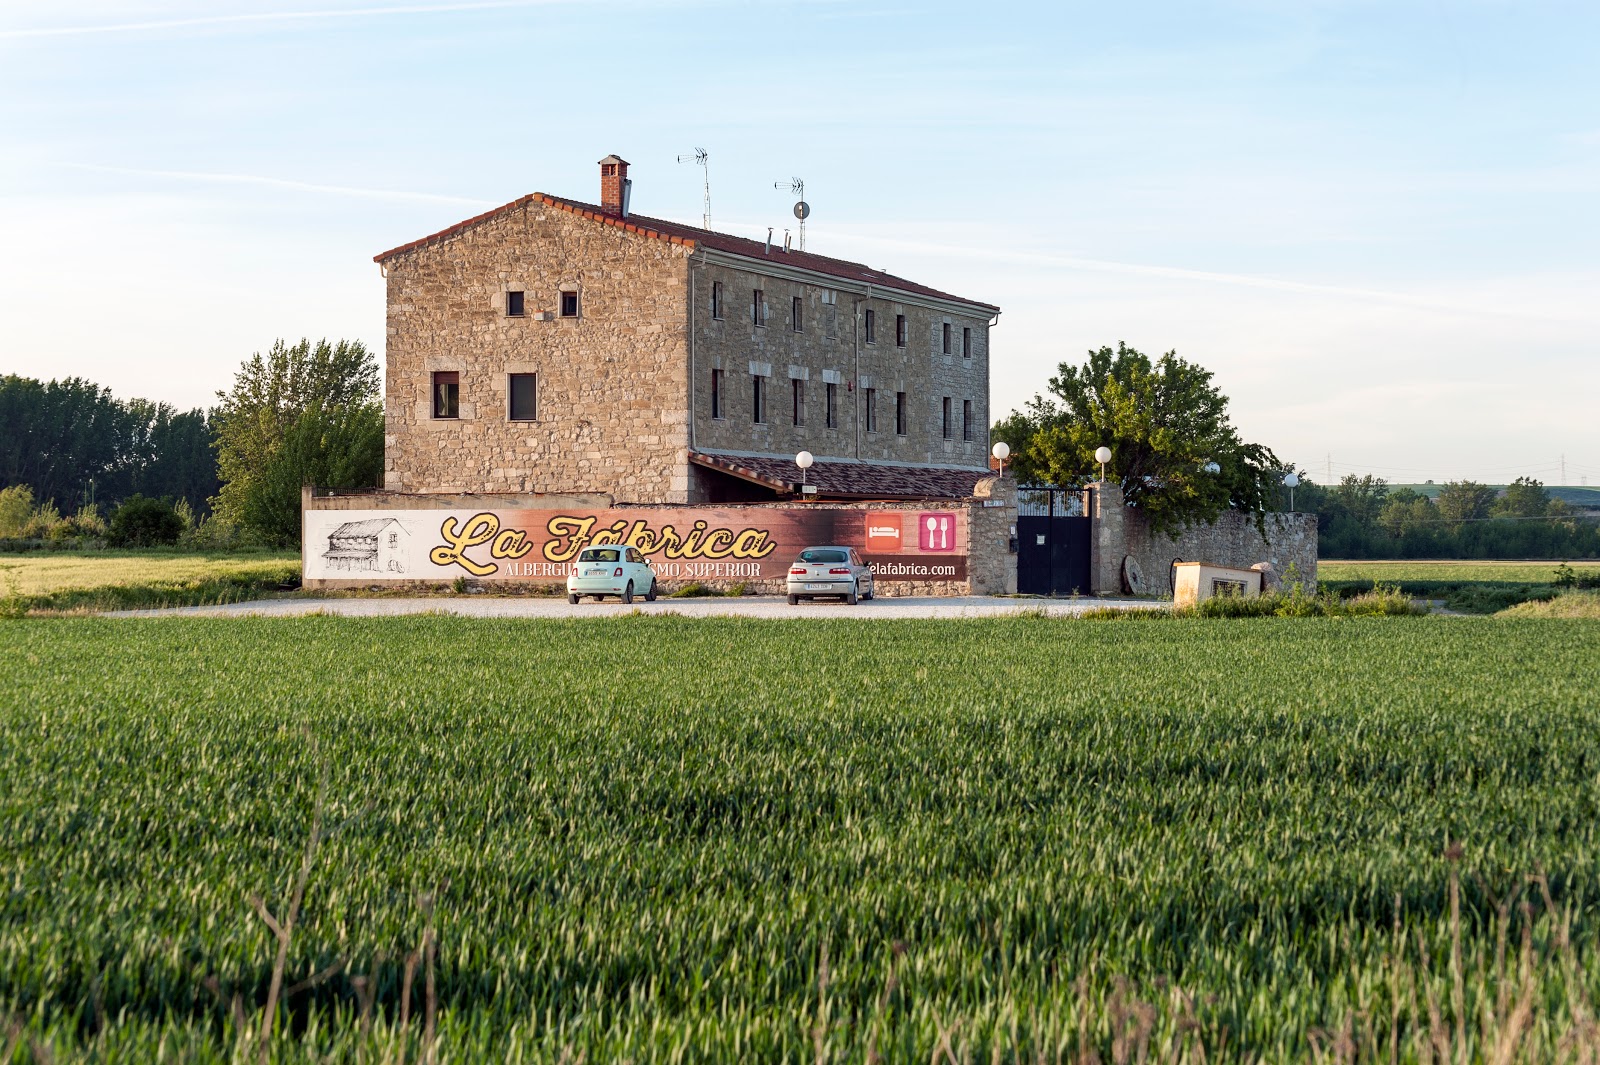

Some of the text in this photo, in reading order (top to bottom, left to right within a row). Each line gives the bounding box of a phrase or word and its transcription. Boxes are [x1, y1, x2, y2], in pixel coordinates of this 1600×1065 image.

[429, 512, 776, 577] La Fábrica
[504, 562, 761, 577] ALBERGU SMO SUPERIOR
[868, 562, 956, 576] elafabrica.com
